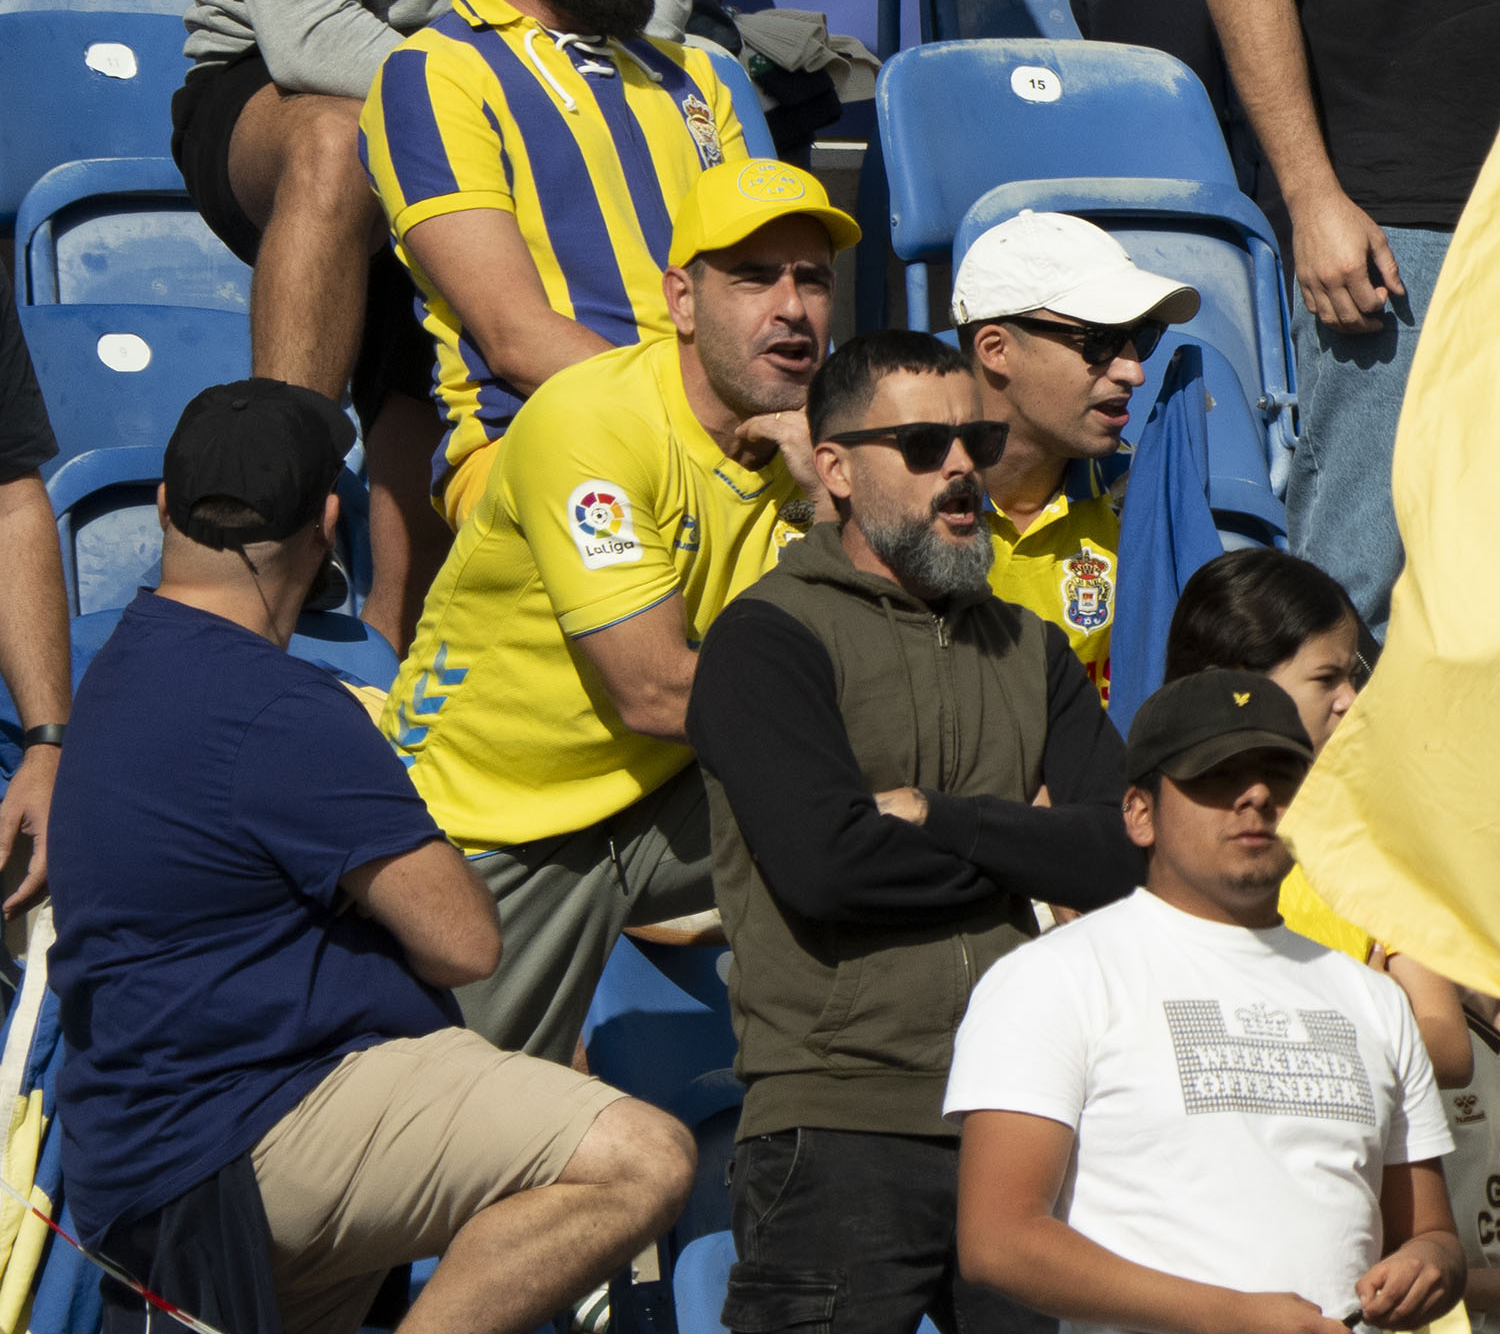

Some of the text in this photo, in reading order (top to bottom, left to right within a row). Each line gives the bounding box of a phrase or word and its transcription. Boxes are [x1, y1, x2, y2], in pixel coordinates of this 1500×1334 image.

[1029, 78, 1047, 91] 15
[585, 538, 636, 558] LaLiga
[1194, 1045, 1356, 1079] WEEKEND
[1192, 1073, 1363, 1107] OFFENDER
